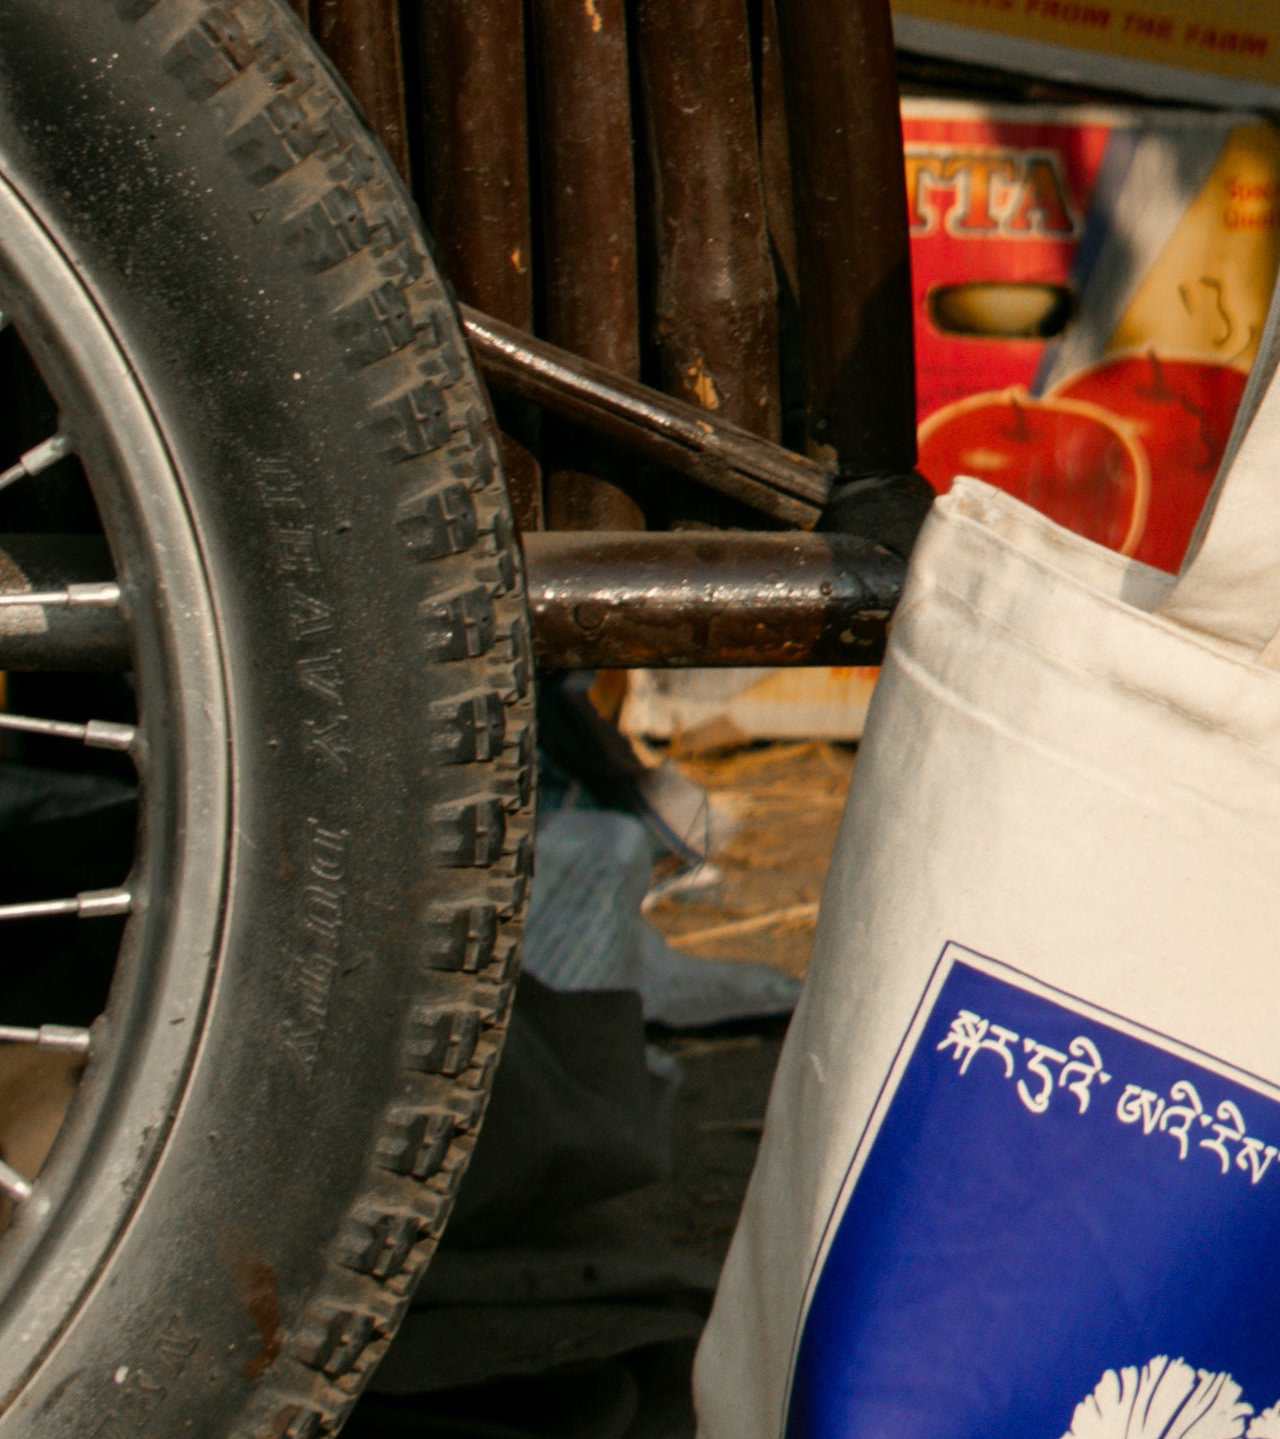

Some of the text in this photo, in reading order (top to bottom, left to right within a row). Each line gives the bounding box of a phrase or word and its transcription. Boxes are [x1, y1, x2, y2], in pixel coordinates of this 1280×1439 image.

[1121, 10, 1176, 41] THE
[1183, 20, 1271, 58] FARM
[255, 454, 351, 1081] HEAVY DUTY
